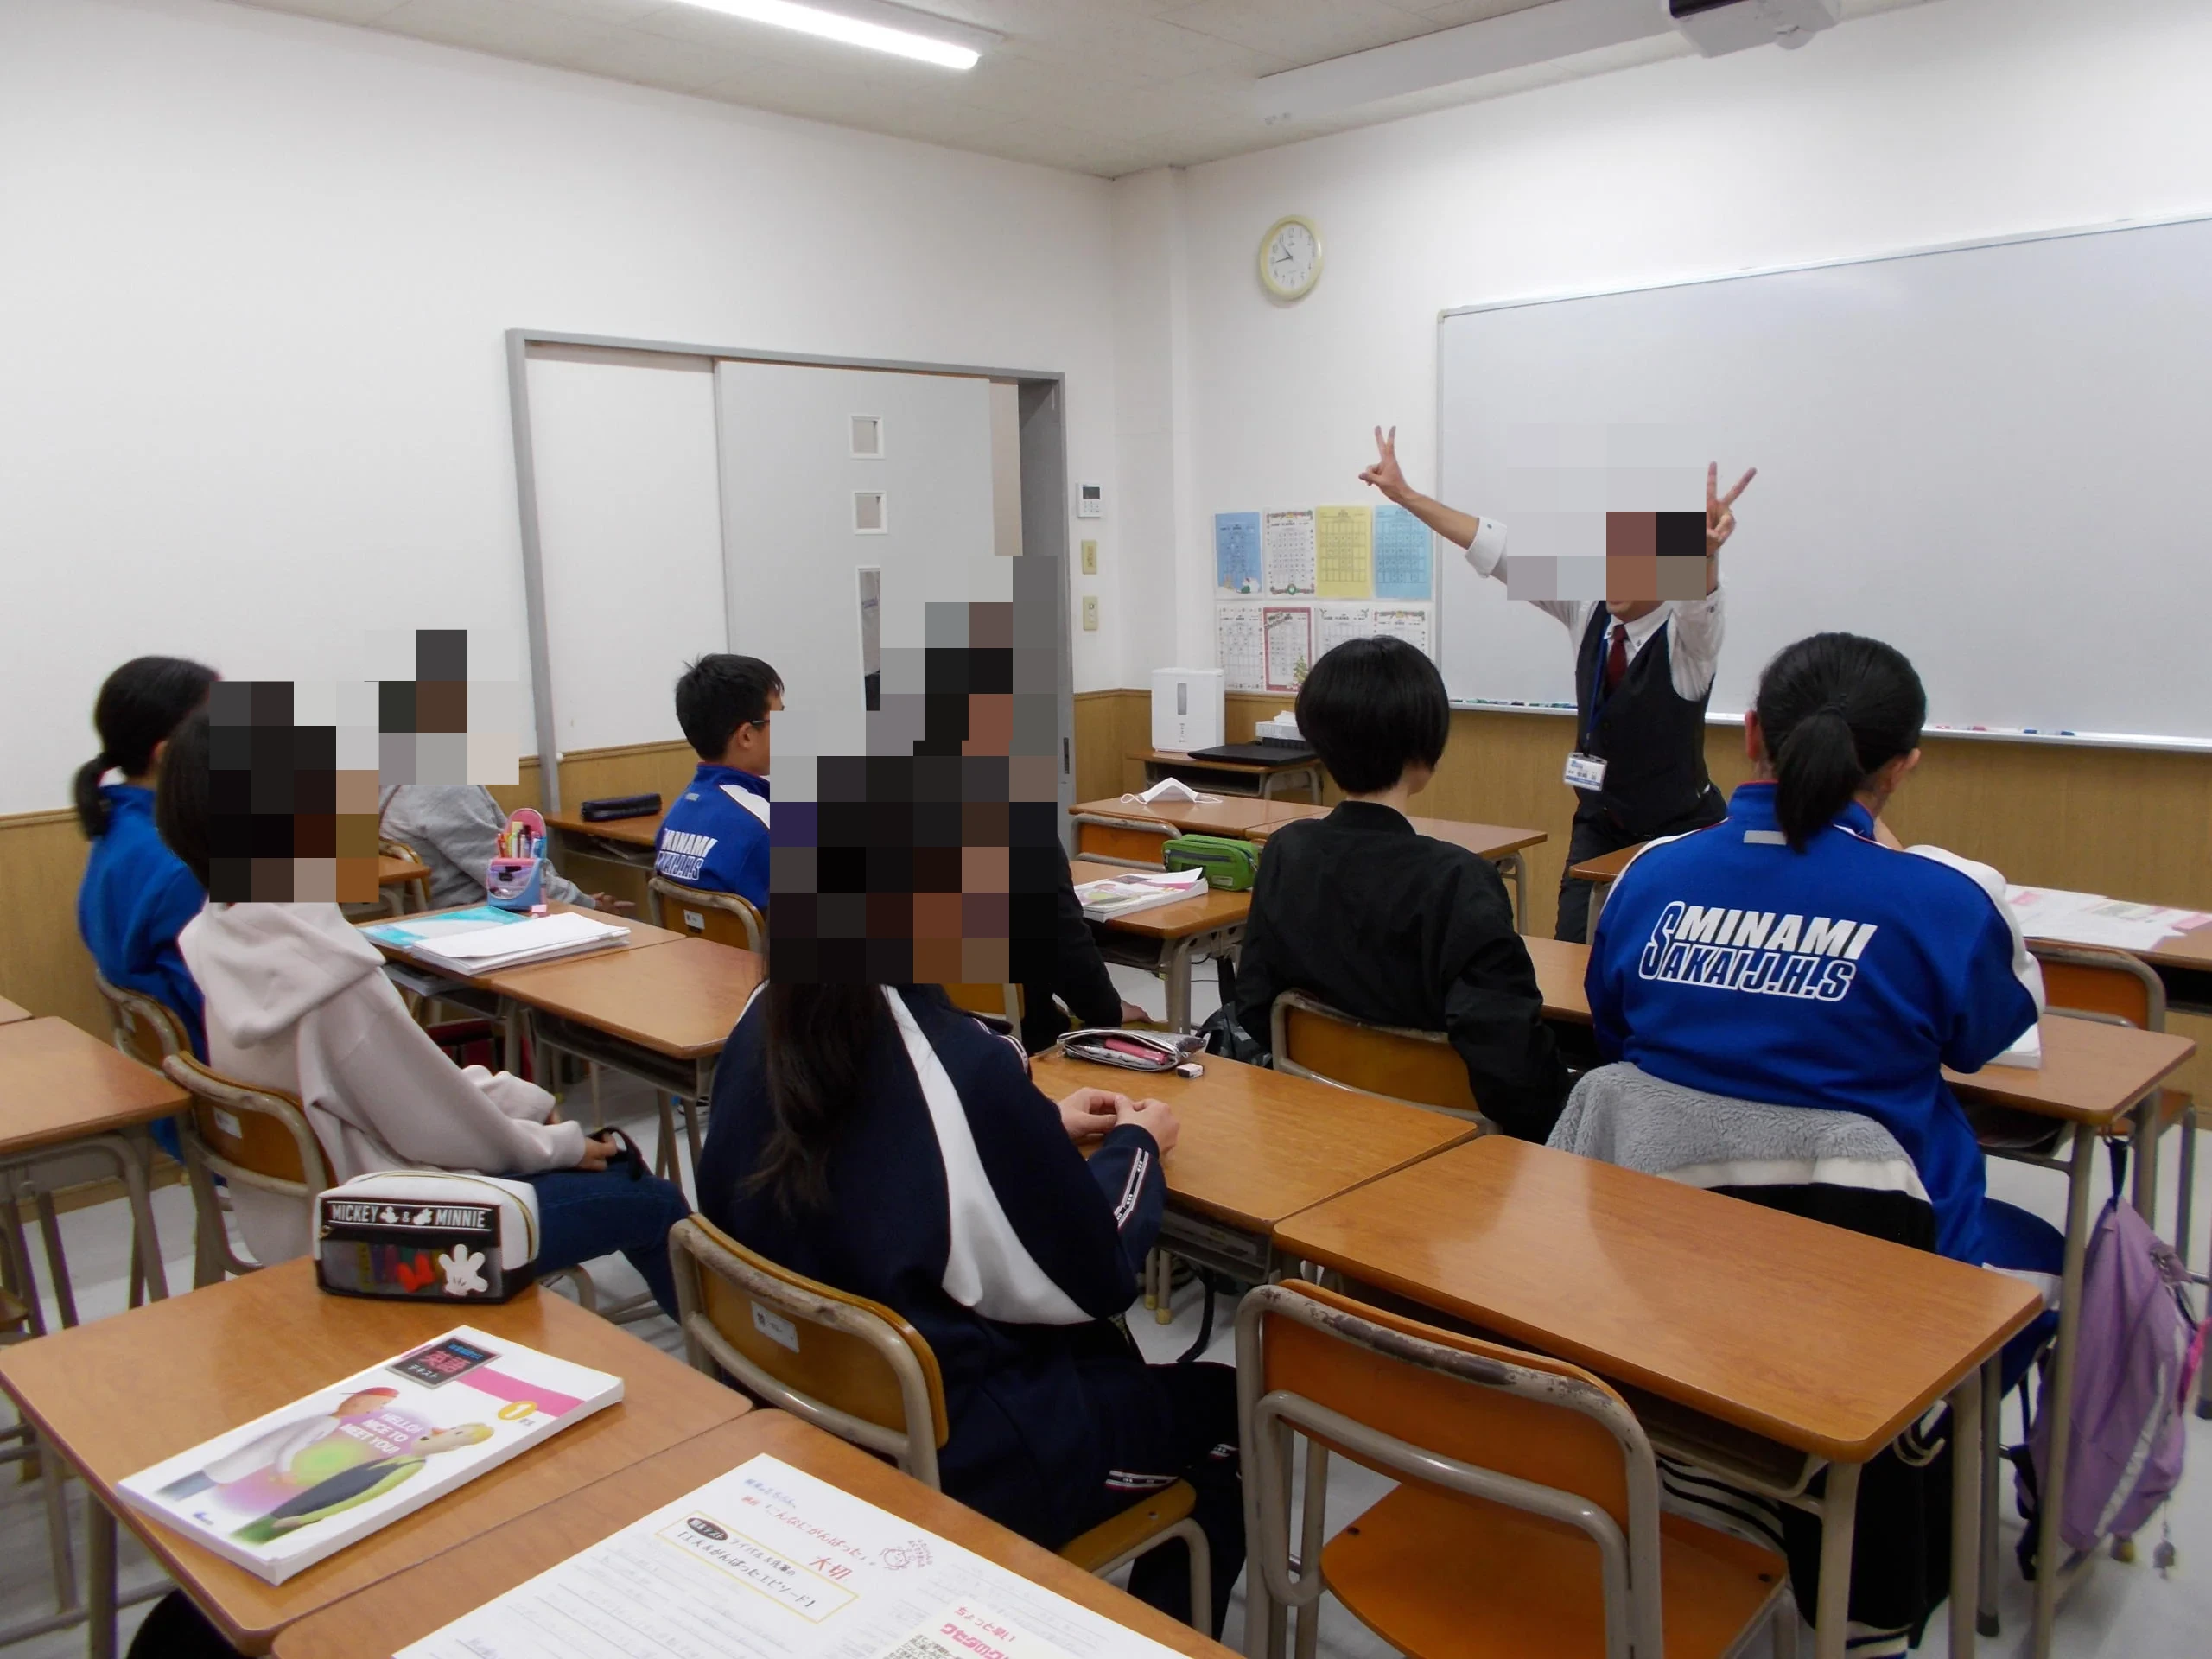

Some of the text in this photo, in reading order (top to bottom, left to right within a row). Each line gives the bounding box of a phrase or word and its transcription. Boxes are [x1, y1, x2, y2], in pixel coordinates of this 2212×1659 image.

[661, 830, 718, 858] MINAMI
[1675, 905, 1878, 961] MINAMI
[332, 1204, 486, 1229] MICKEY & MINNIE
[408, 1364, 439, 1379] テキスト
[420, 1351, 471, 1374] 英語
[339, 1423, 374, 1440] MEET
[362, 1419, 410, 1442] NICE TO
[380, 1412, 423, 1434] HELLO!
[809, 1556, 853, 1580] 大切
